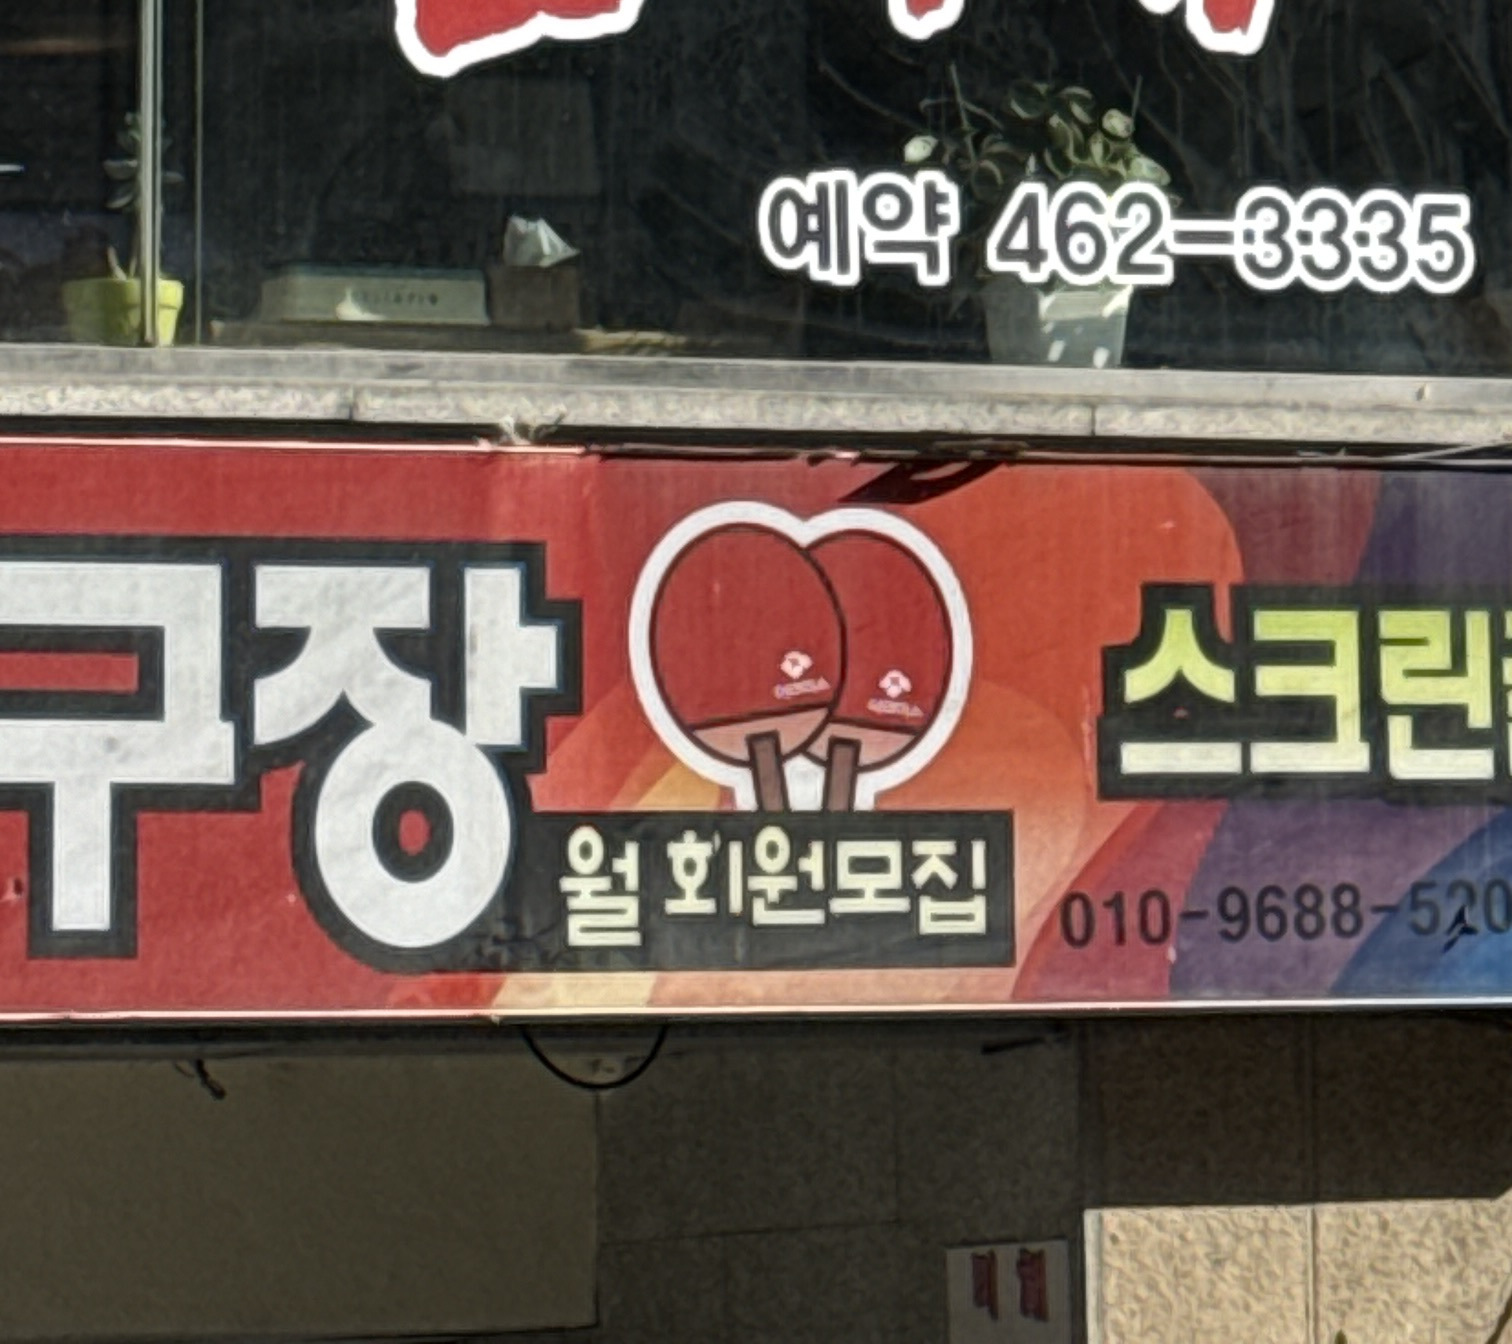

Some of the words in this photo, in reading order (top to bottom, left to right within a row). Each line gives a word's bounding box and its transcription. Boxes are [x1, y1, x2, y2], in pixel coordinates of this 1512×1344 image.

[758, 169, 959, 284] 예약
[987, 180, 1474, 292] 462-3335
[0, 560, 560, 949] 구장
[559, 825, 642, 947] 월
[664, 825, 987, 934] 회원모집
